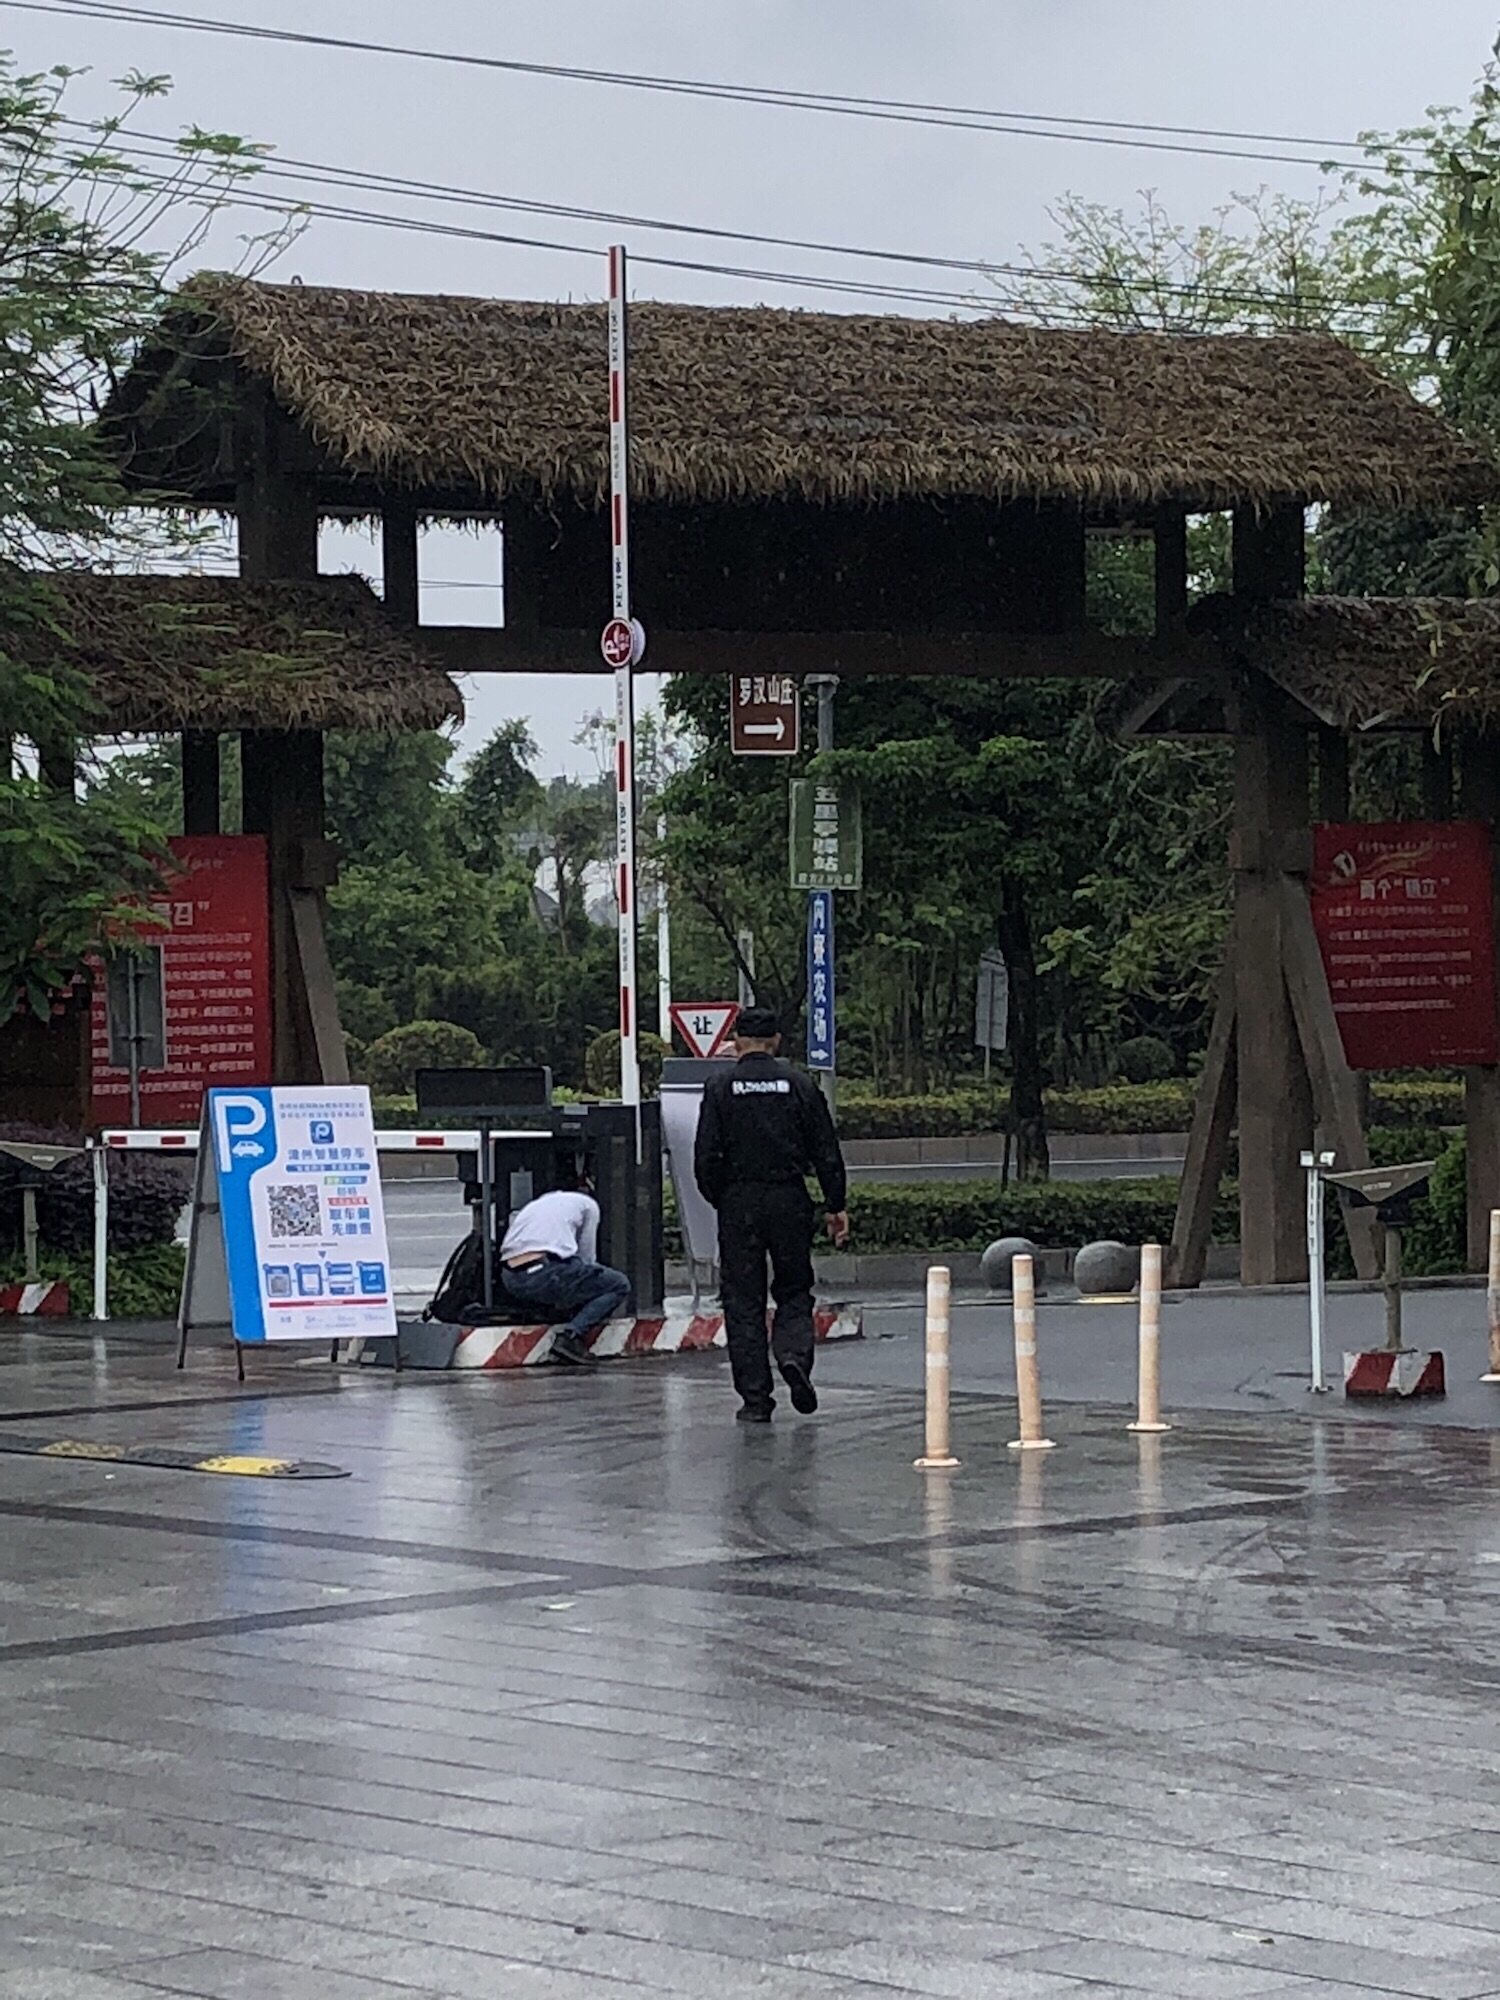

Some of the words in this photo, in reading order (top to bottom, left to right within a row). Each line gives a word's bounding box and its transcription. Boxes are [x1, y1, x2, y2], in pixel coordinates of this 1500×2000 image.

[739, 676, 794, 706] 罗汉山庄
[692, 1016, 713, 1035] 让
[213, 1095, 267, 1173] P
